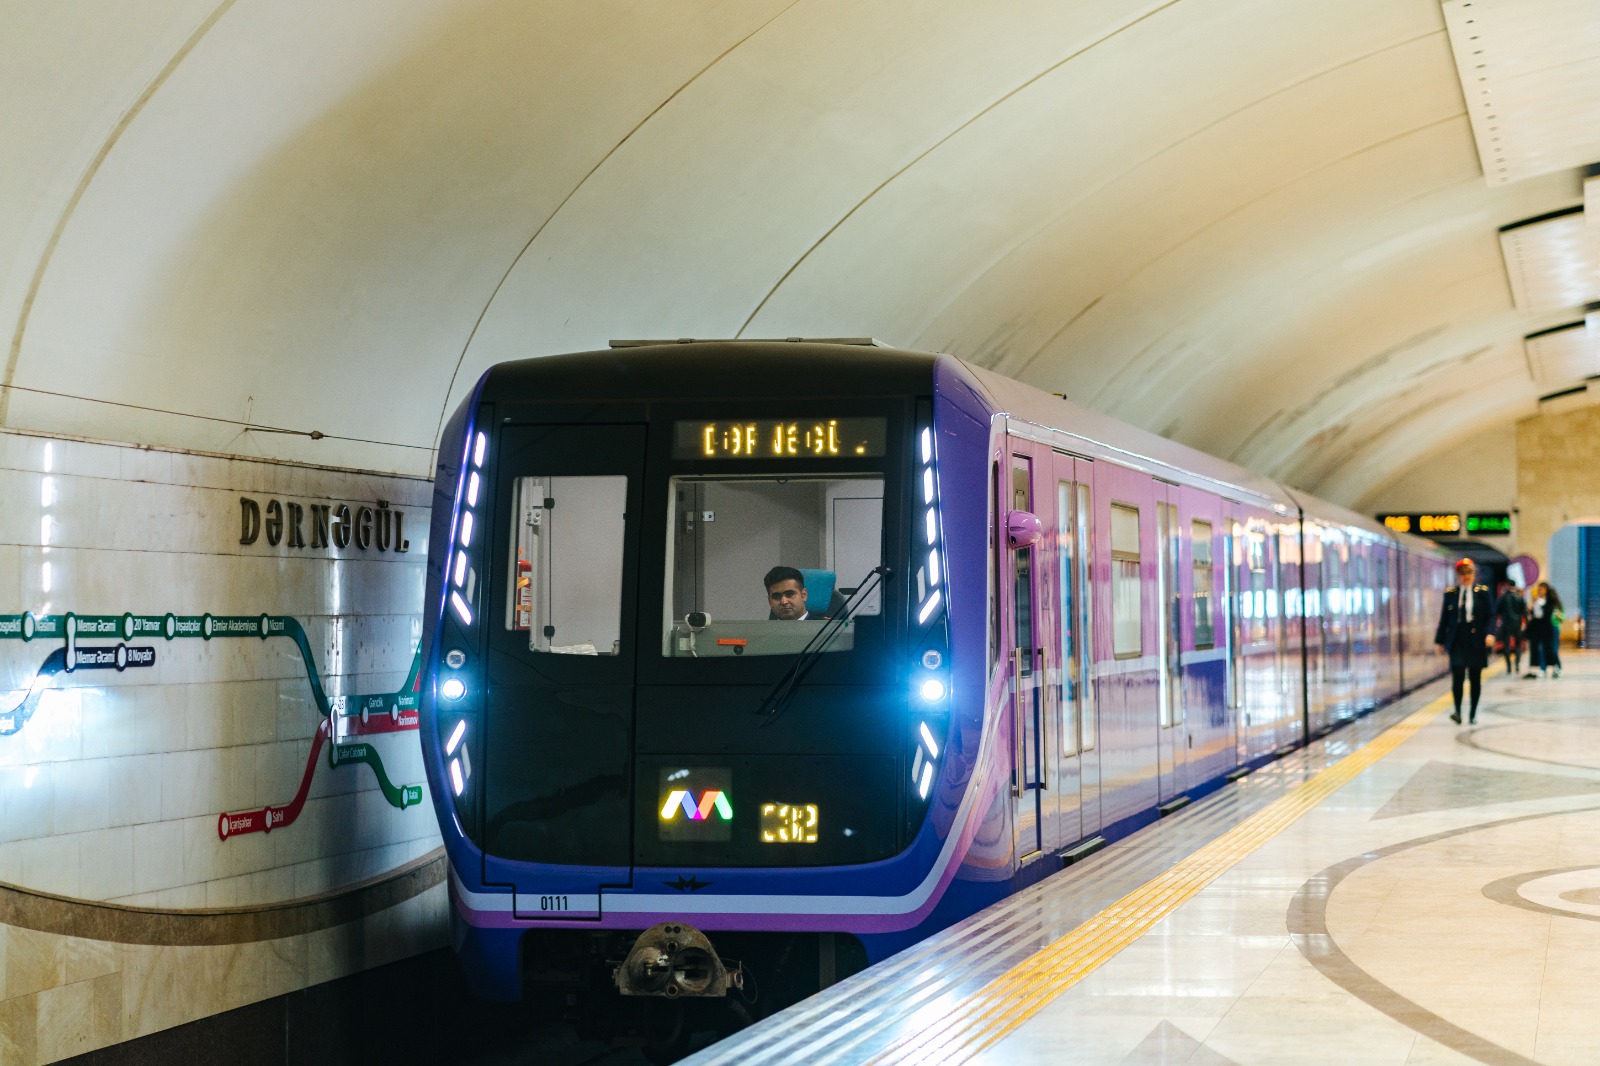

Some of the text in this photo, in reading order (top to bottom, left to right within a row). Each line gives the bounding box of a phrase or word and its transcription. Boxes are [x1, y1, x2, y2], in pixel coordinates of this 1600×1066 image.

[239, 496, 410, 553] DƏRNƏGÜL
[77, 619, 97, 632] Memar
[134, 618, 161, 631] 20 Yanvar
[269, 619, 285, 631] Nizami
[76, 650, 97, 664] Memar
[127, 649, 153, 664] 8 Noyabr
[272, 810, 284, 823] Sahil
[540, 895, 568, 911] 0111
